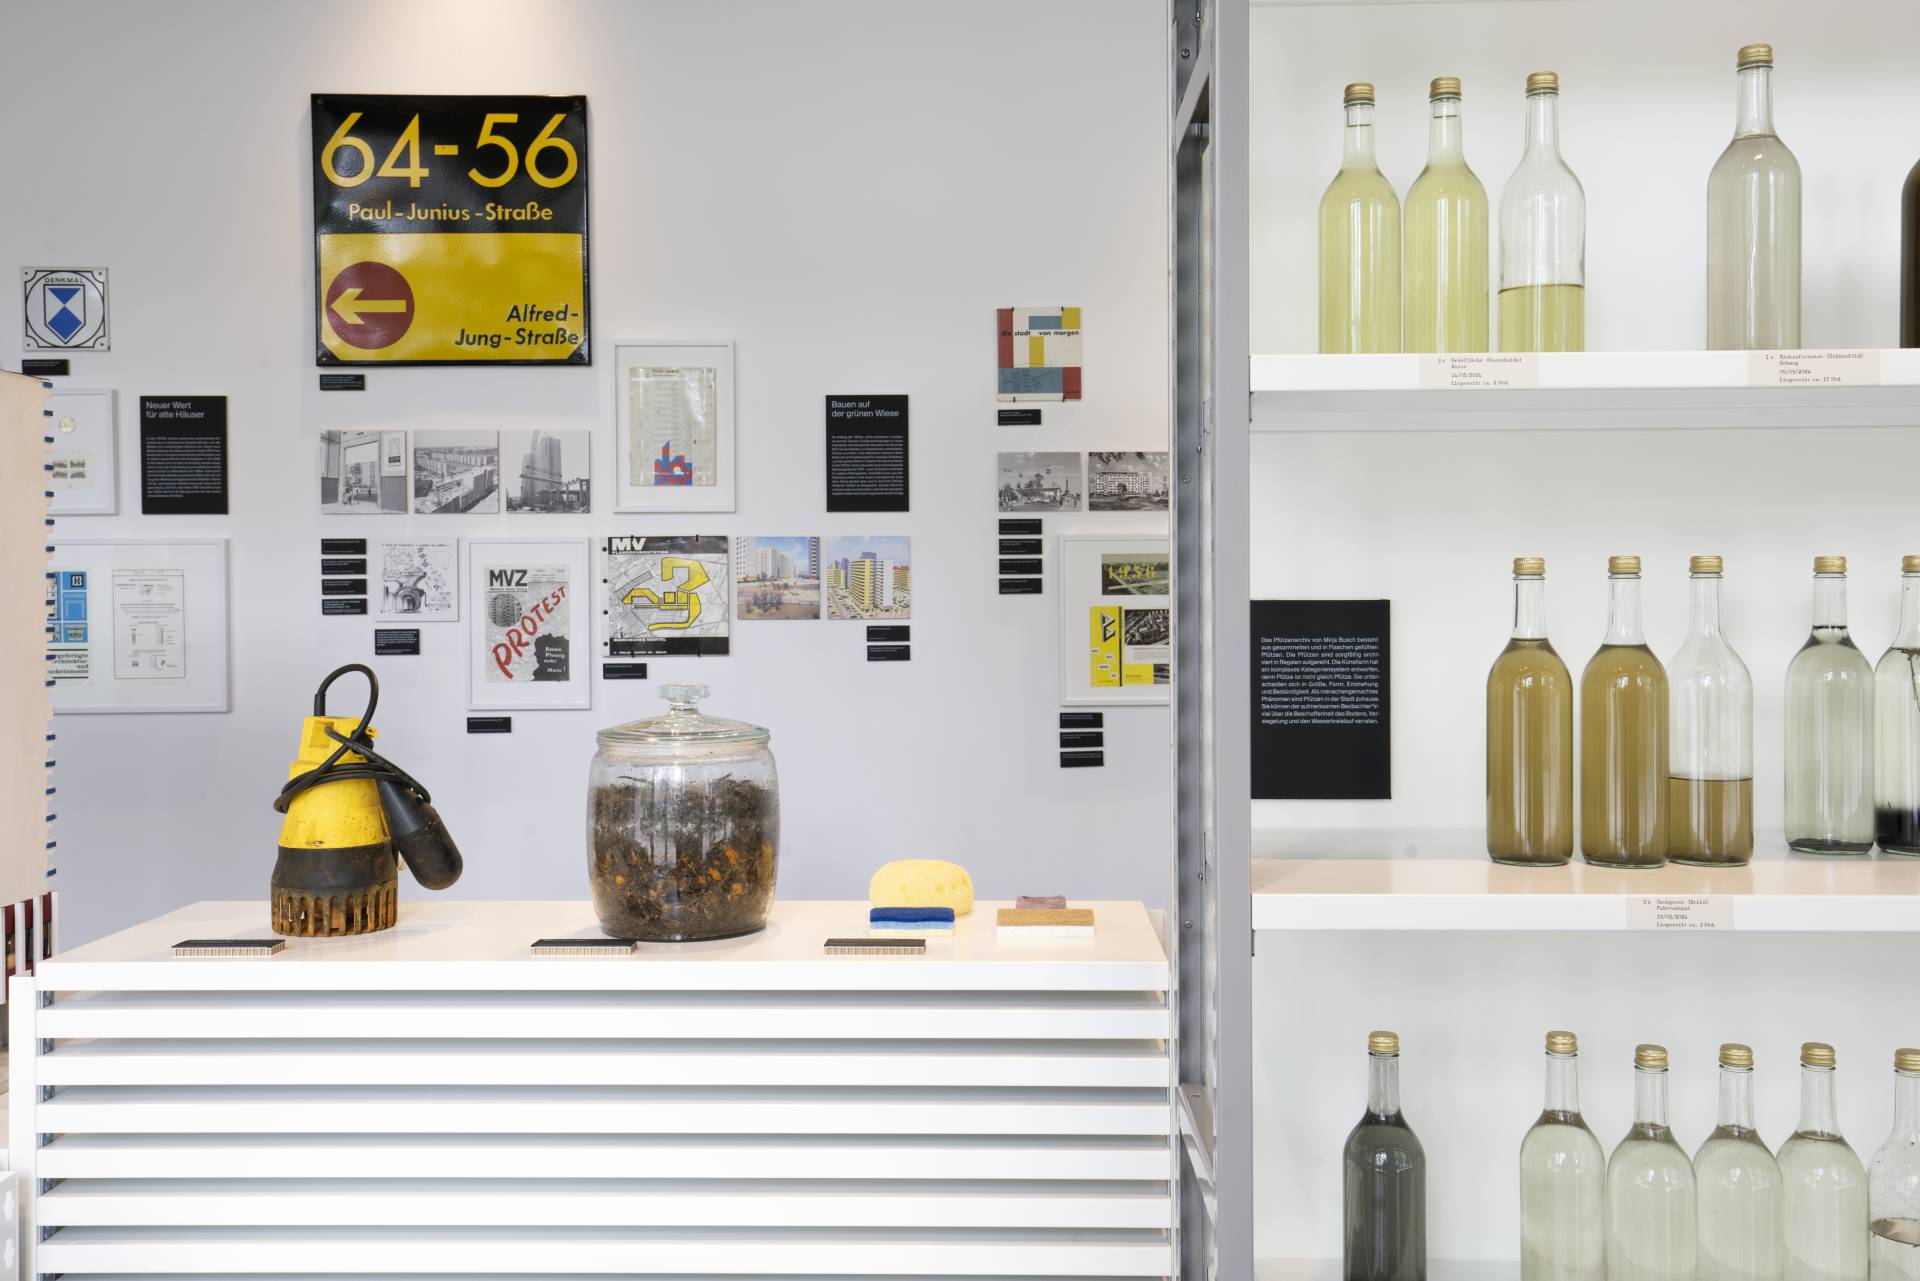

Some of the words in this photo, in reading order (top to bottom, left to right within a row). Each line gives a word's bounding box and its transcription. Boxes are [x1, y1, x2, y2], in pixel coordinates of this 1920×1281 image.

[506, 304, 579, 322] Alfred-
[454, 328, 580, 348] Jung-Straße
[846, 410, 873, 418] grünen
[612, 538, 646, 550] MV
[490, 570, 527, 586] MVZ
[492, 585, 567, 679] PROTEST
